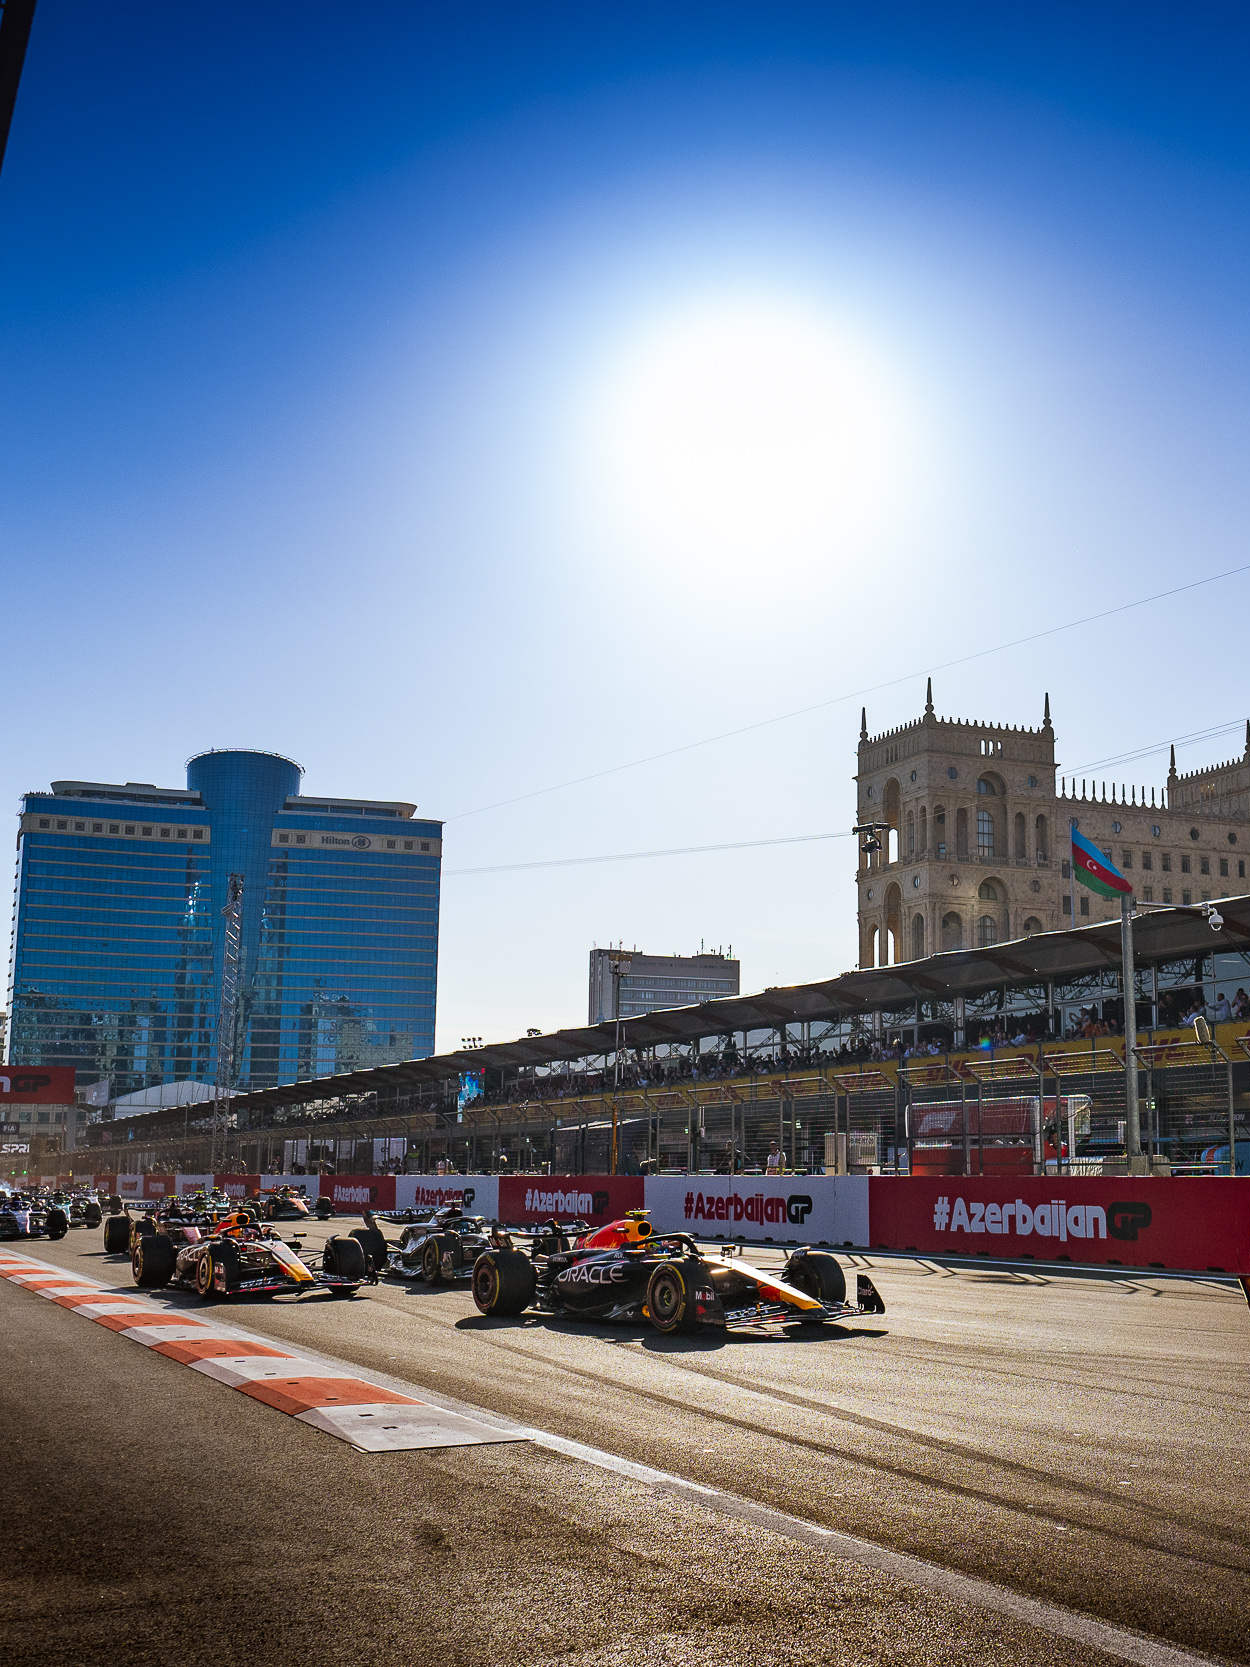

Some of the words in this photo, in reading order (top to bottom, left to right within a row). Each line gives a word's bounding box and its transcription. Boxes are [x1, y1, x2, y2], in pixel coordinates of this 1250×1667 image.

[321, 836, 350, 845] Hilton
[684, 1192, 813, 1226] #AzerbaijanGP
[933, 1196, 1153, 1242] #AzerbaijanGP
[557, 1265, 629, 1284] ORACLE
[695, 1290, 715, 1301] Mobil
